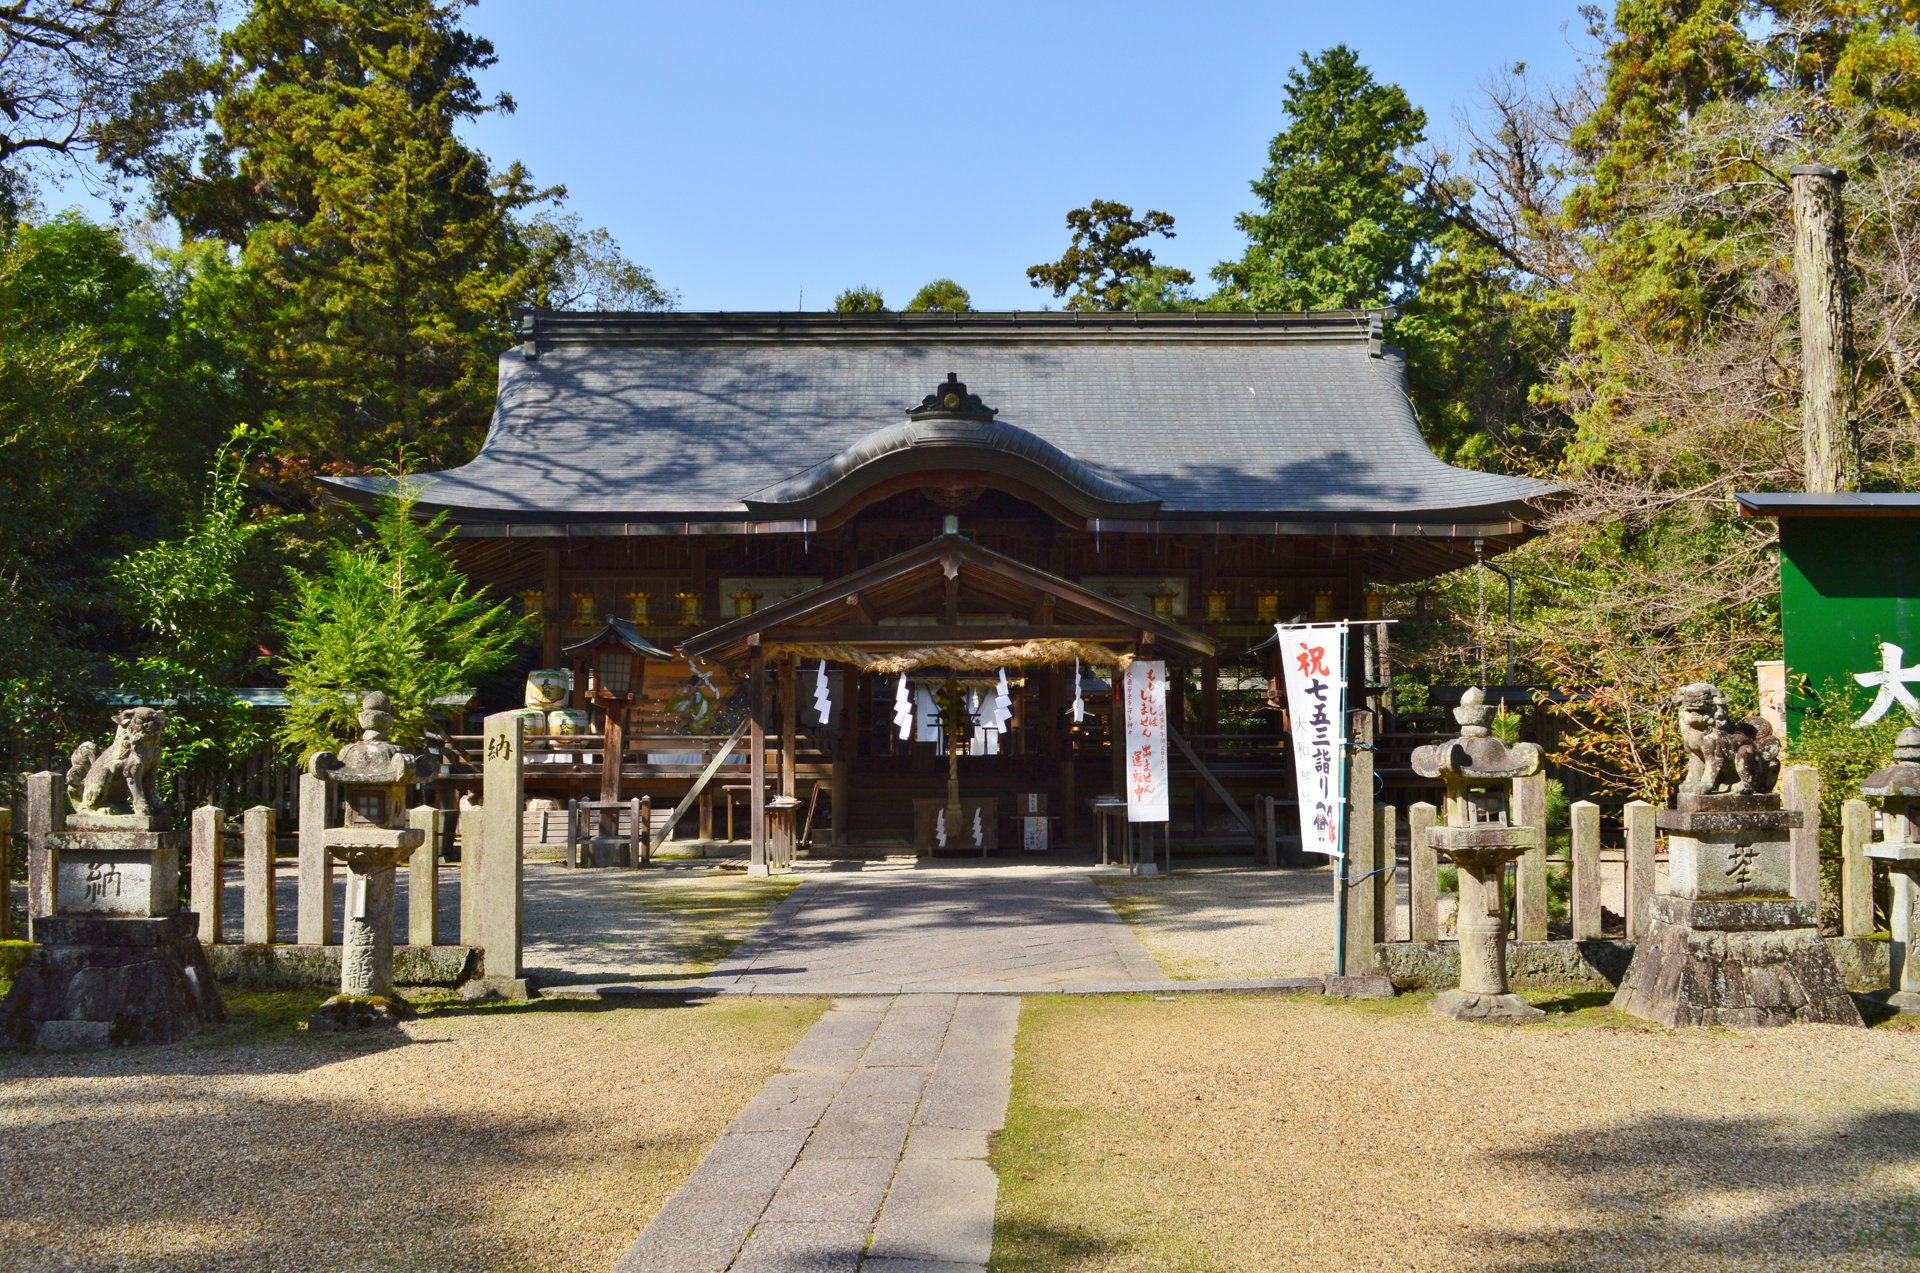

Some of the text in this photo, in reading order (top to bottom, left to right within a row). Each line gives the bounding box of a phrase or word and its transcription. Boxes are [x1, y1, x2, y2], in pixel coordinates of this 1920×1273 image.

[1853, 642, 1920, 728] 大
[487, 733, 514, 762] 納
[1142, 743, 1155, 794] 出ません
[1132, 750, 1144, 802] 運転中
[83, 860, 122, 904] 納
